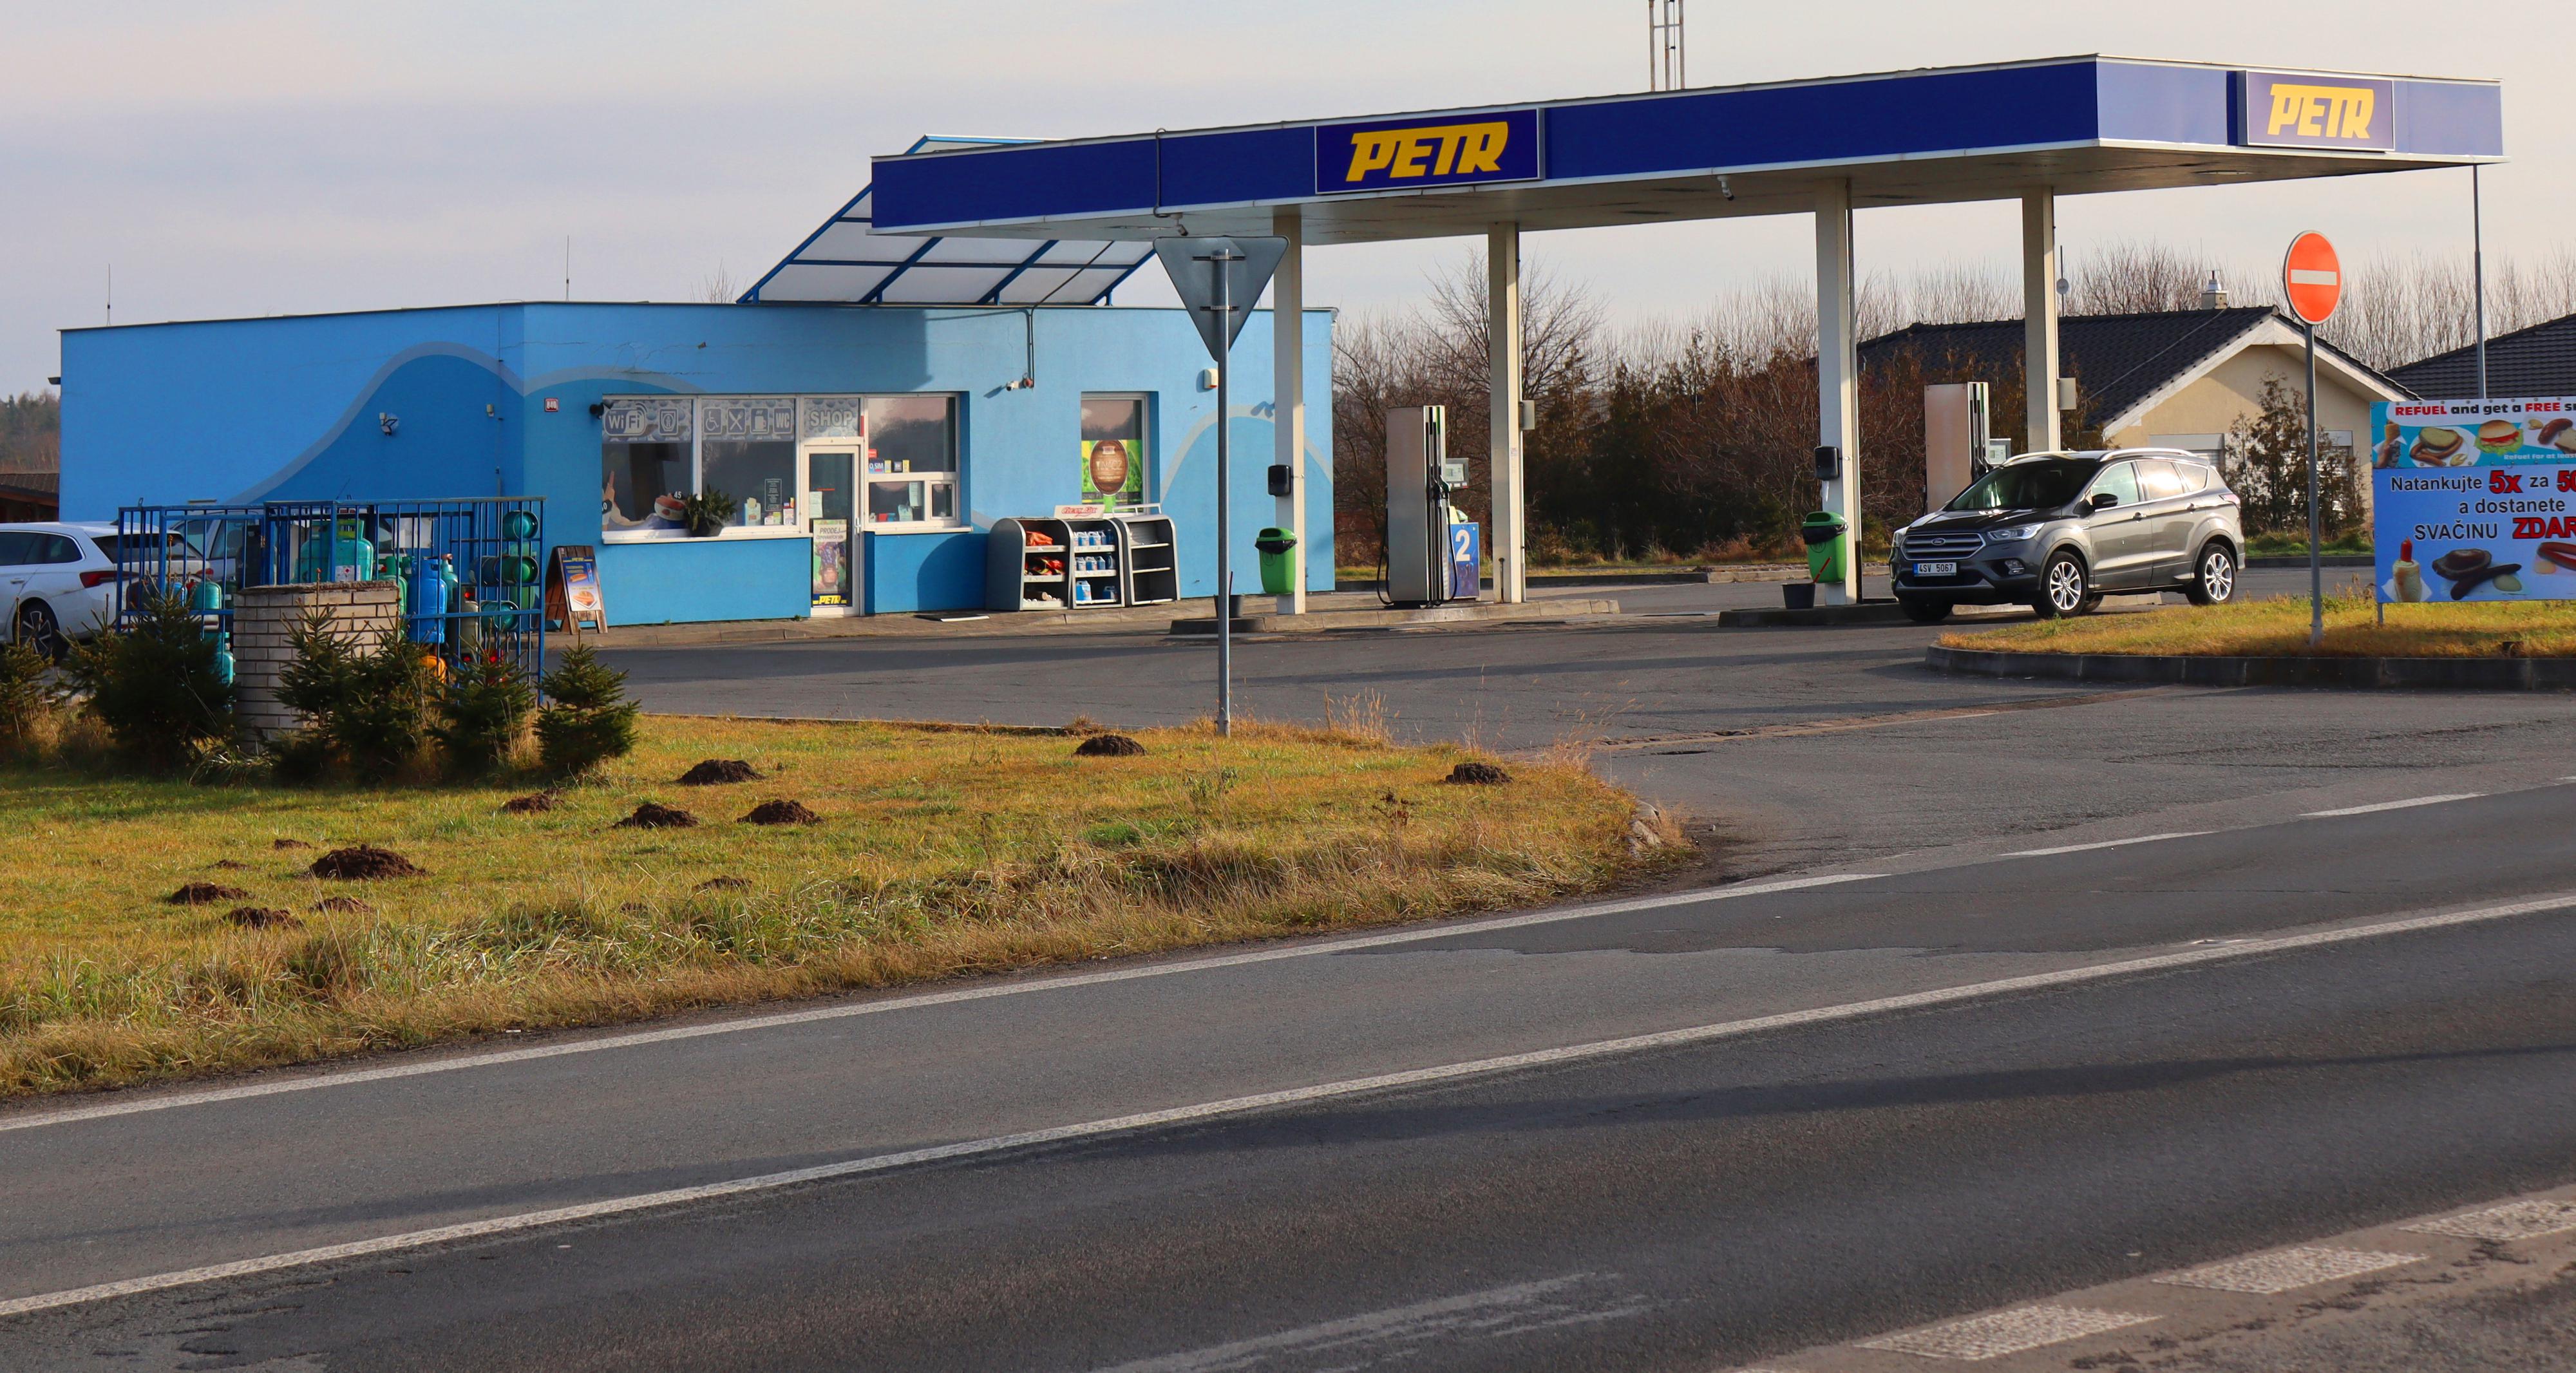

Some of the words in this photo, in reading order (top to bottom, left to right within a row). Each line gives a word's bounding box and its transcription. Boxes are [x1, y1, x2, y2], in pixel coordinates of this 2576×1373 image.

[2267, 83, 2374, 139] PETR
[1345, 121, 1509, 182] PETR
[2395, 406, 2447, 416] REFUEL
[2450, 404, 2479, 414] and
[2483, 404, 2508, 415] get
[2525, 402, 2561, 412] FREE
[776, 412, 791, 428] WC
[810, 410, 853, 427] SHOP
[2391, 476, 2482, 493] Natankujte
[2489, 470, 2523, 495] 5x
[2529, 476, 2549, 488] za
[674, 491, 682, 499] 45
[2459, 502, 2468, 514] a
[2475, 497, 2566, 514] dostanete
[2414, 519, 2497, 540] SVAČINU
[1455, 529, 1471, 562] 2
[1919, 564, 1931, 573] 4SV
[1936, 563, 1953, 573] 5067
[819, 595, 841, 605] PETR
